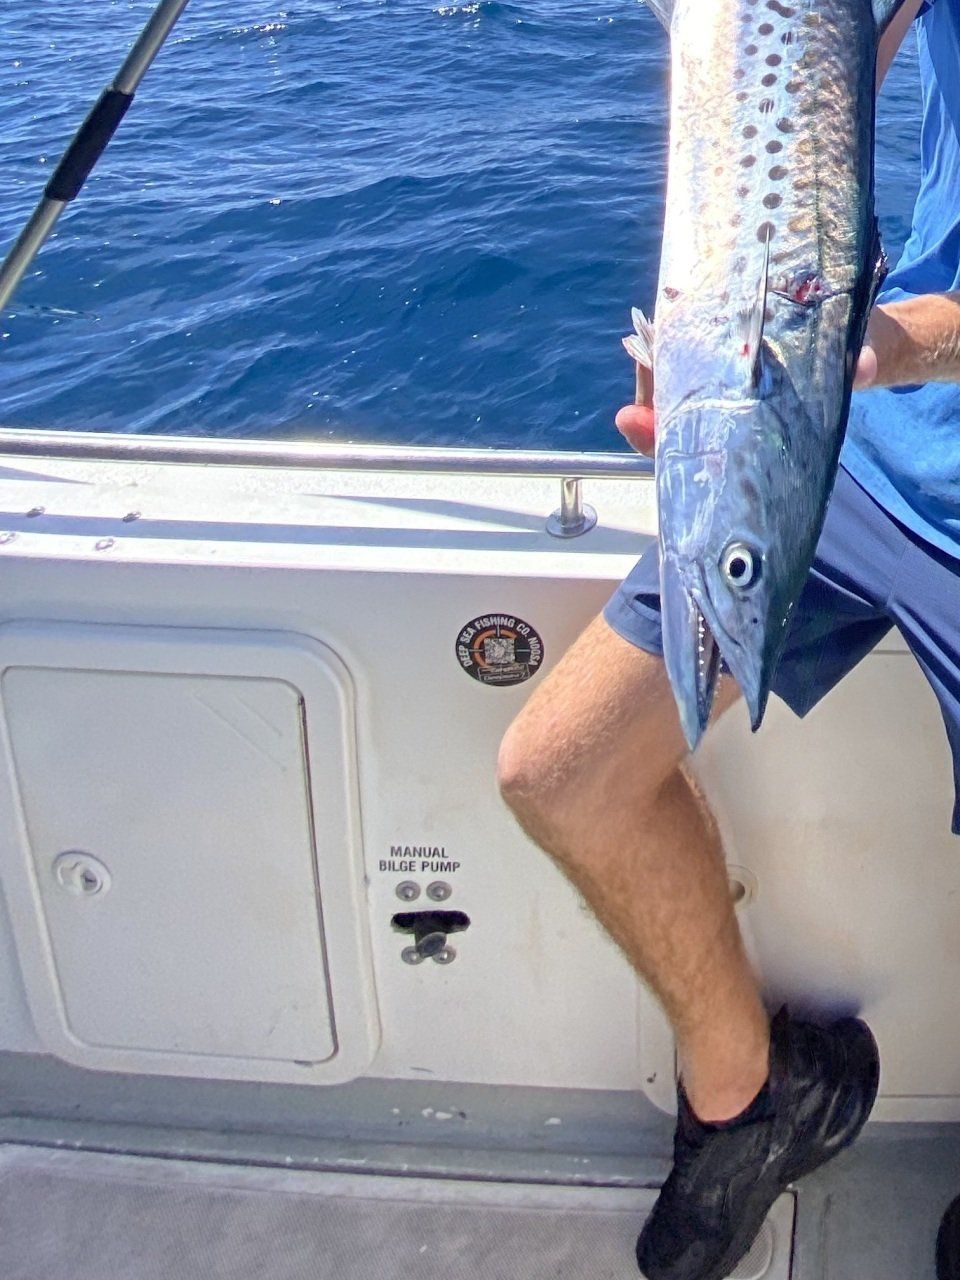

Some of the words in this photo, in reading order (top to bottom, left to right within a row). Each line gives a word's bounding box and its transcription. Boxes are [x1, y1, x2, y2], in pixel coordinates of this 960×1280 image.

[474, 616, 516, 630] FISHING
[516, 623, 530, 637] CO.
[460, 627, 477, 643] SEA
[458, 645, 473, 667] DEEP
[528, 636, 541, 666] NOOSA
[390, 846, 449, 858] MANUAL
[379, 860, 416, 872] BILGE
[421, 861, 461, 872] PUMP
